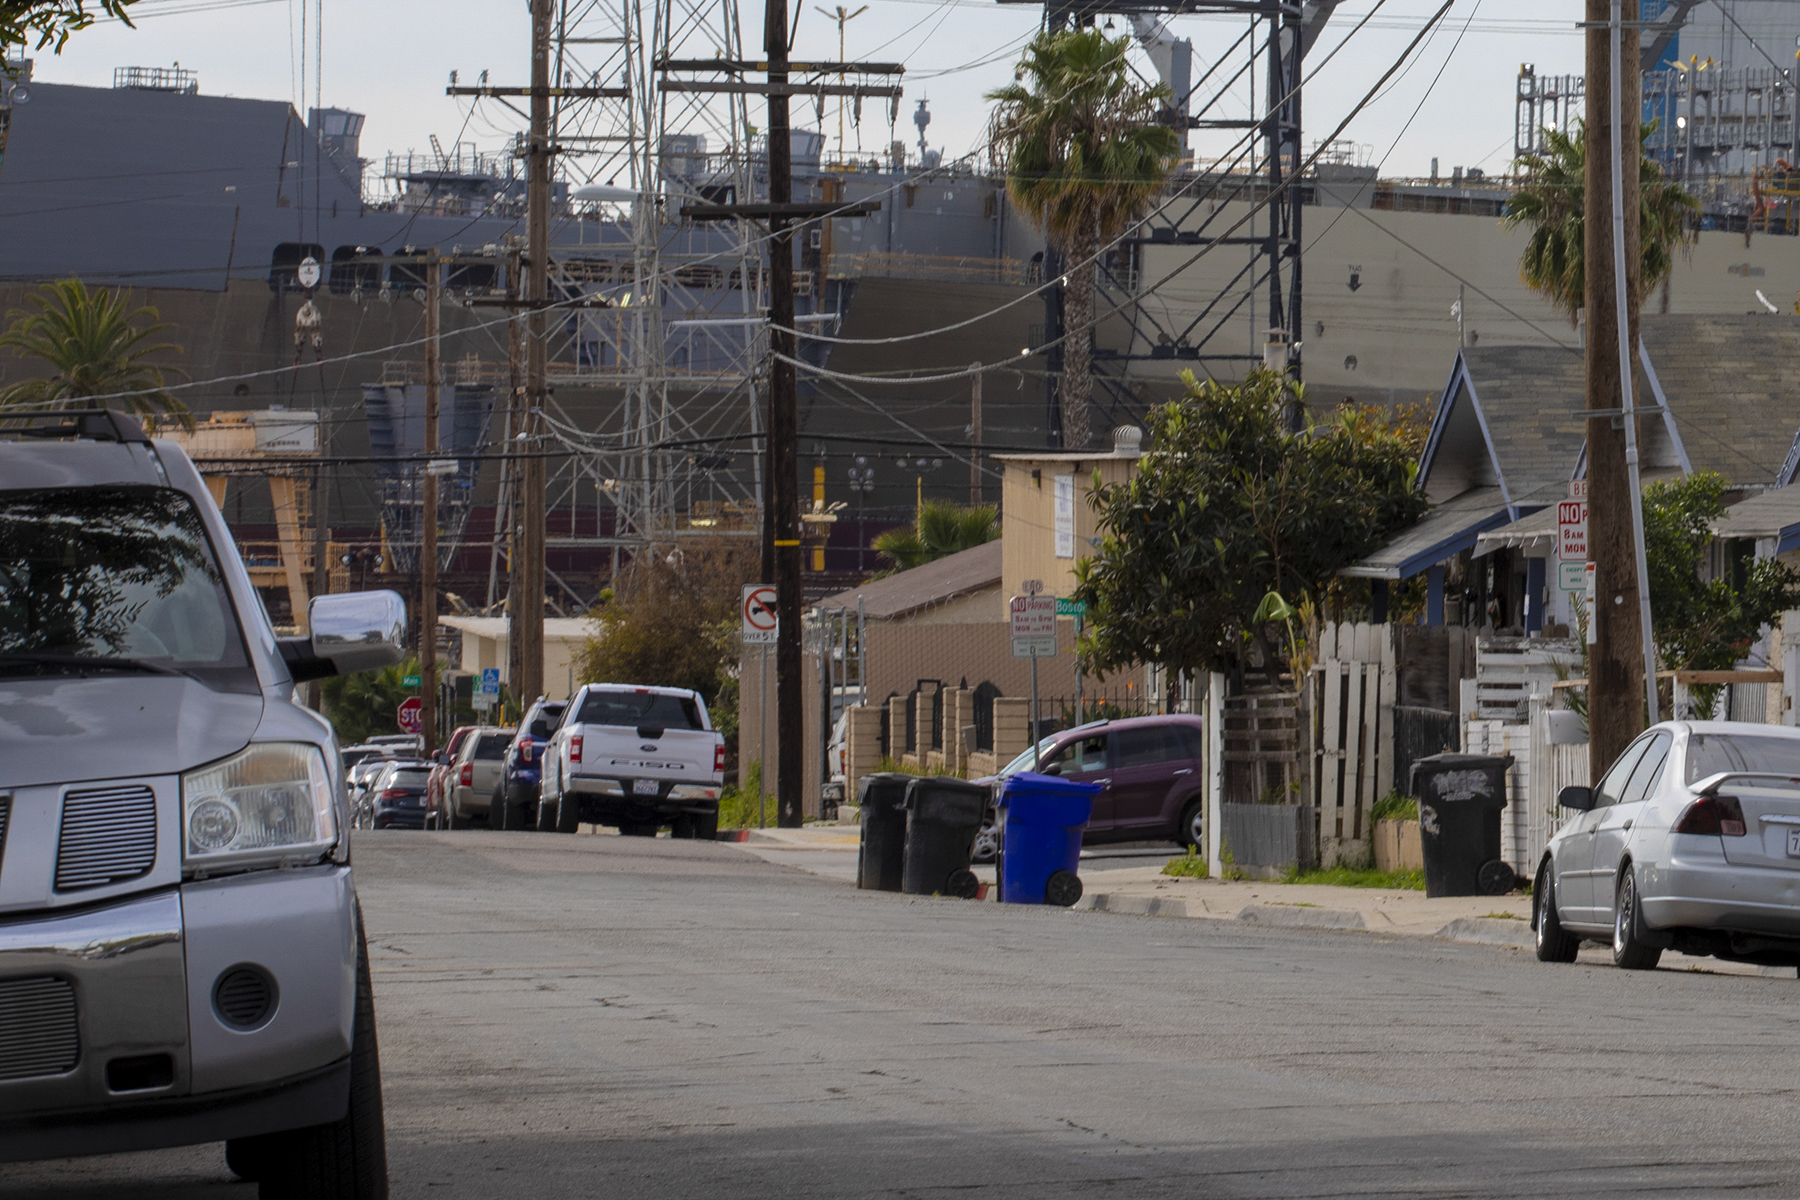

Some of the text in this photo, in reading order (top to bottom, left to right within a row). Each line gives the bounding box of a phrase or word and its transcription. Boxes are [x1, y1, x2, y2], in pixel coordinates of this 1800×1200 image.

[1560, 504, 1579, 523] NO
[1565, 544, 1586, 553] MON
[1013, 598, 1053, 611] NO PARKING
